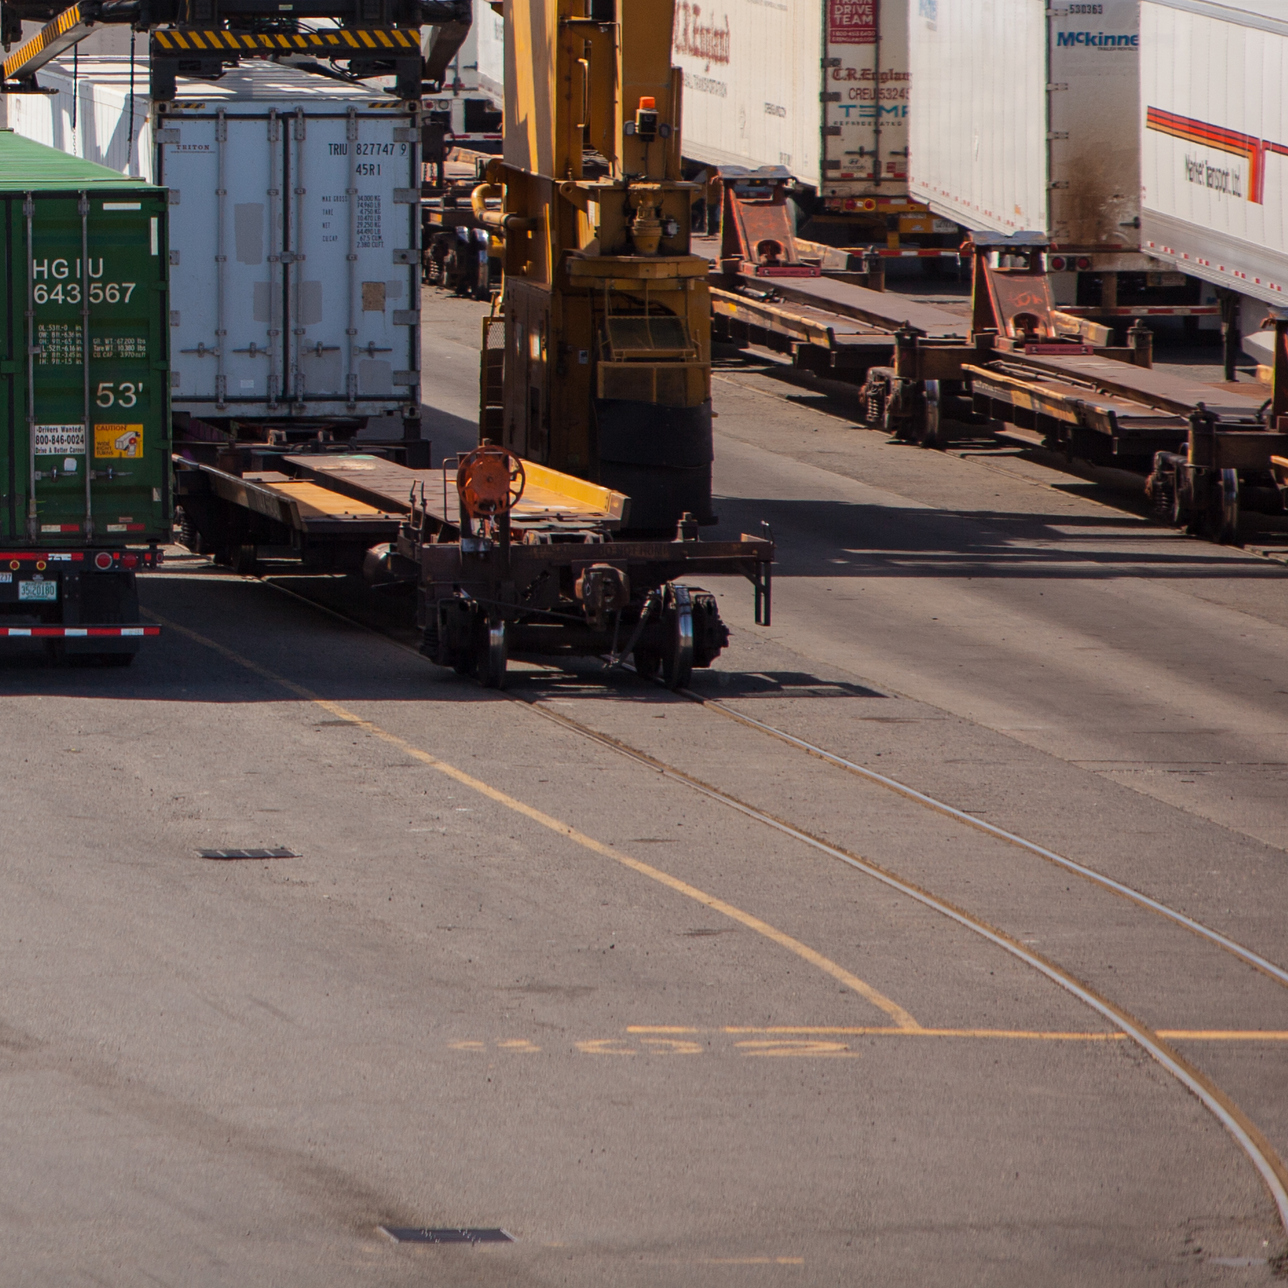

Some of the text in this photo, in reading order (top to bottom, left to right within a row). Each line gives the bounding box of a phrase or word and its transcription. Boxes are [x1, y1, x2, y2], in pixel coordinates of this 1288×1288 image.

[834, 5, 874, 15] DRIVE
[1069, 4, 1104, 15] 530363
[834, 15, 874, 25] TEAM
[1056, 31, 1139, 47] Mckinne
[832, 67, 912, 83] C.R.Englan
[328, 143, 407, 156] TRIU 827747 9
[355, 163, 382, 176] 45R1
[32, 257, 104, 279] HGIU
[95, 382, 143, 408] 53'
[35, 434, 84, 445] 800-846-0024
